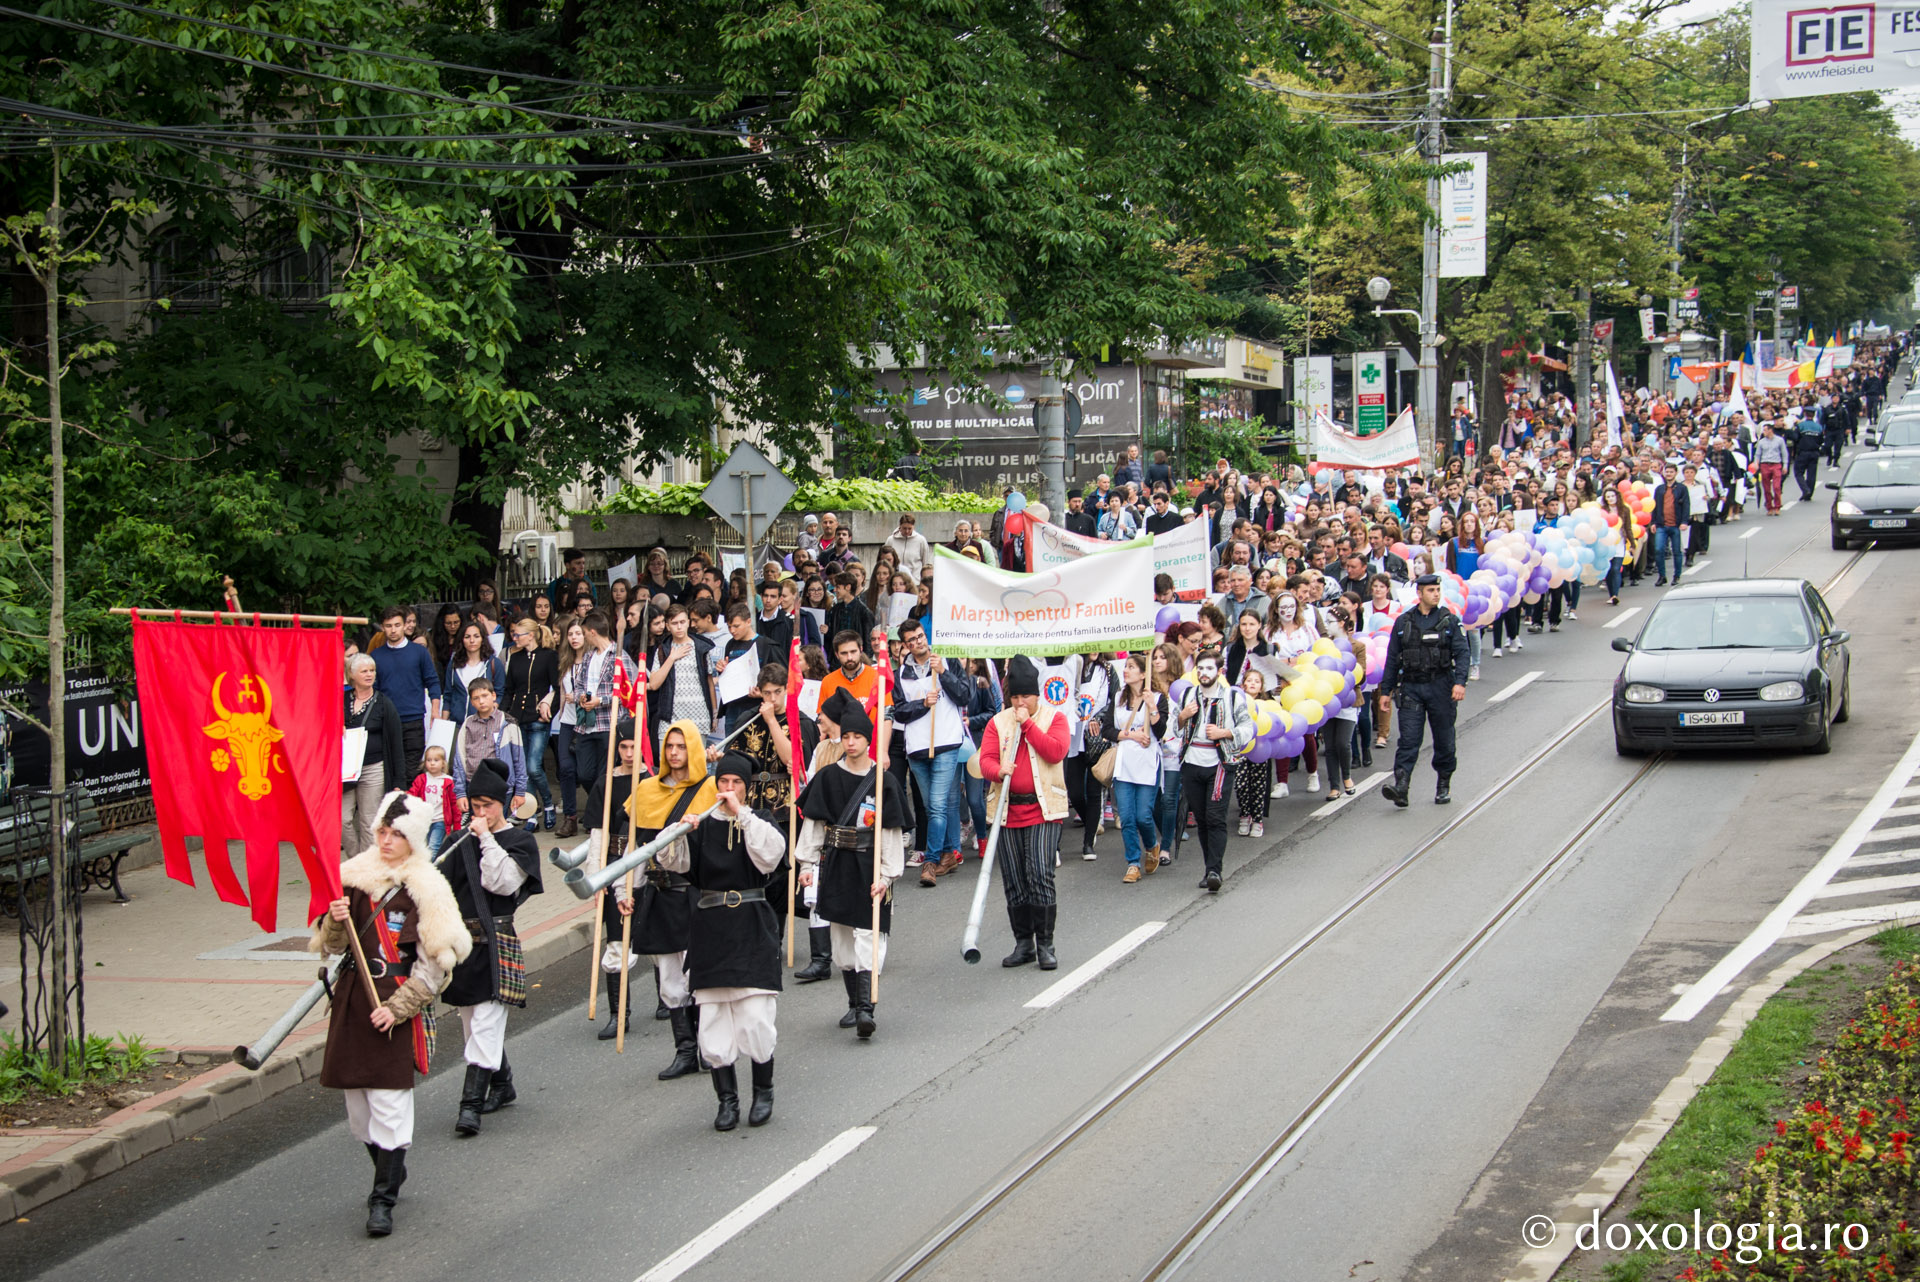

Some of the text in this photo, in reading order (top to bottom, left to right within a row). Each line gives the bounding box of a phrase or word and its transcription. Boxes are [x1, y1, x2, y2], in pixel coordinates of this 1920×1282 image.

[1798, 15, 1863, 55] FIE
[1786, 64, 1874, 80] www.fieiasi.eu
[1678, 309, 1699, 318] stop
[936, 419, 952, 429] DE
[955, 416, 1034, 428] MULTIPLICĂR
[935, 455, 995, 467] CENTRU
[1001, 454, 1020, 466] DE
[1014, 606, 1071, 626] pentru
[1075, 597, 1135, 619] Familie
[936, 630, 980, 639] Eveniment
[982, 631, 993, 639] de
[995, 631, 1044, 639] solidarizare
[1045, 630, 1073, 639] pentru
[1074, 626, 1101, 635] familia
[1053, 645, 1066, 654] Un
[1119, 640, 1127, 649] O
[67, 675, 109, 689] Teatrul
[1722, 712, 1739, 723] KIT
[78, 701, 139, 757] UN
[85, 778, 99, 787] Dan
[100, 768, 140, 784] Teodorovici
